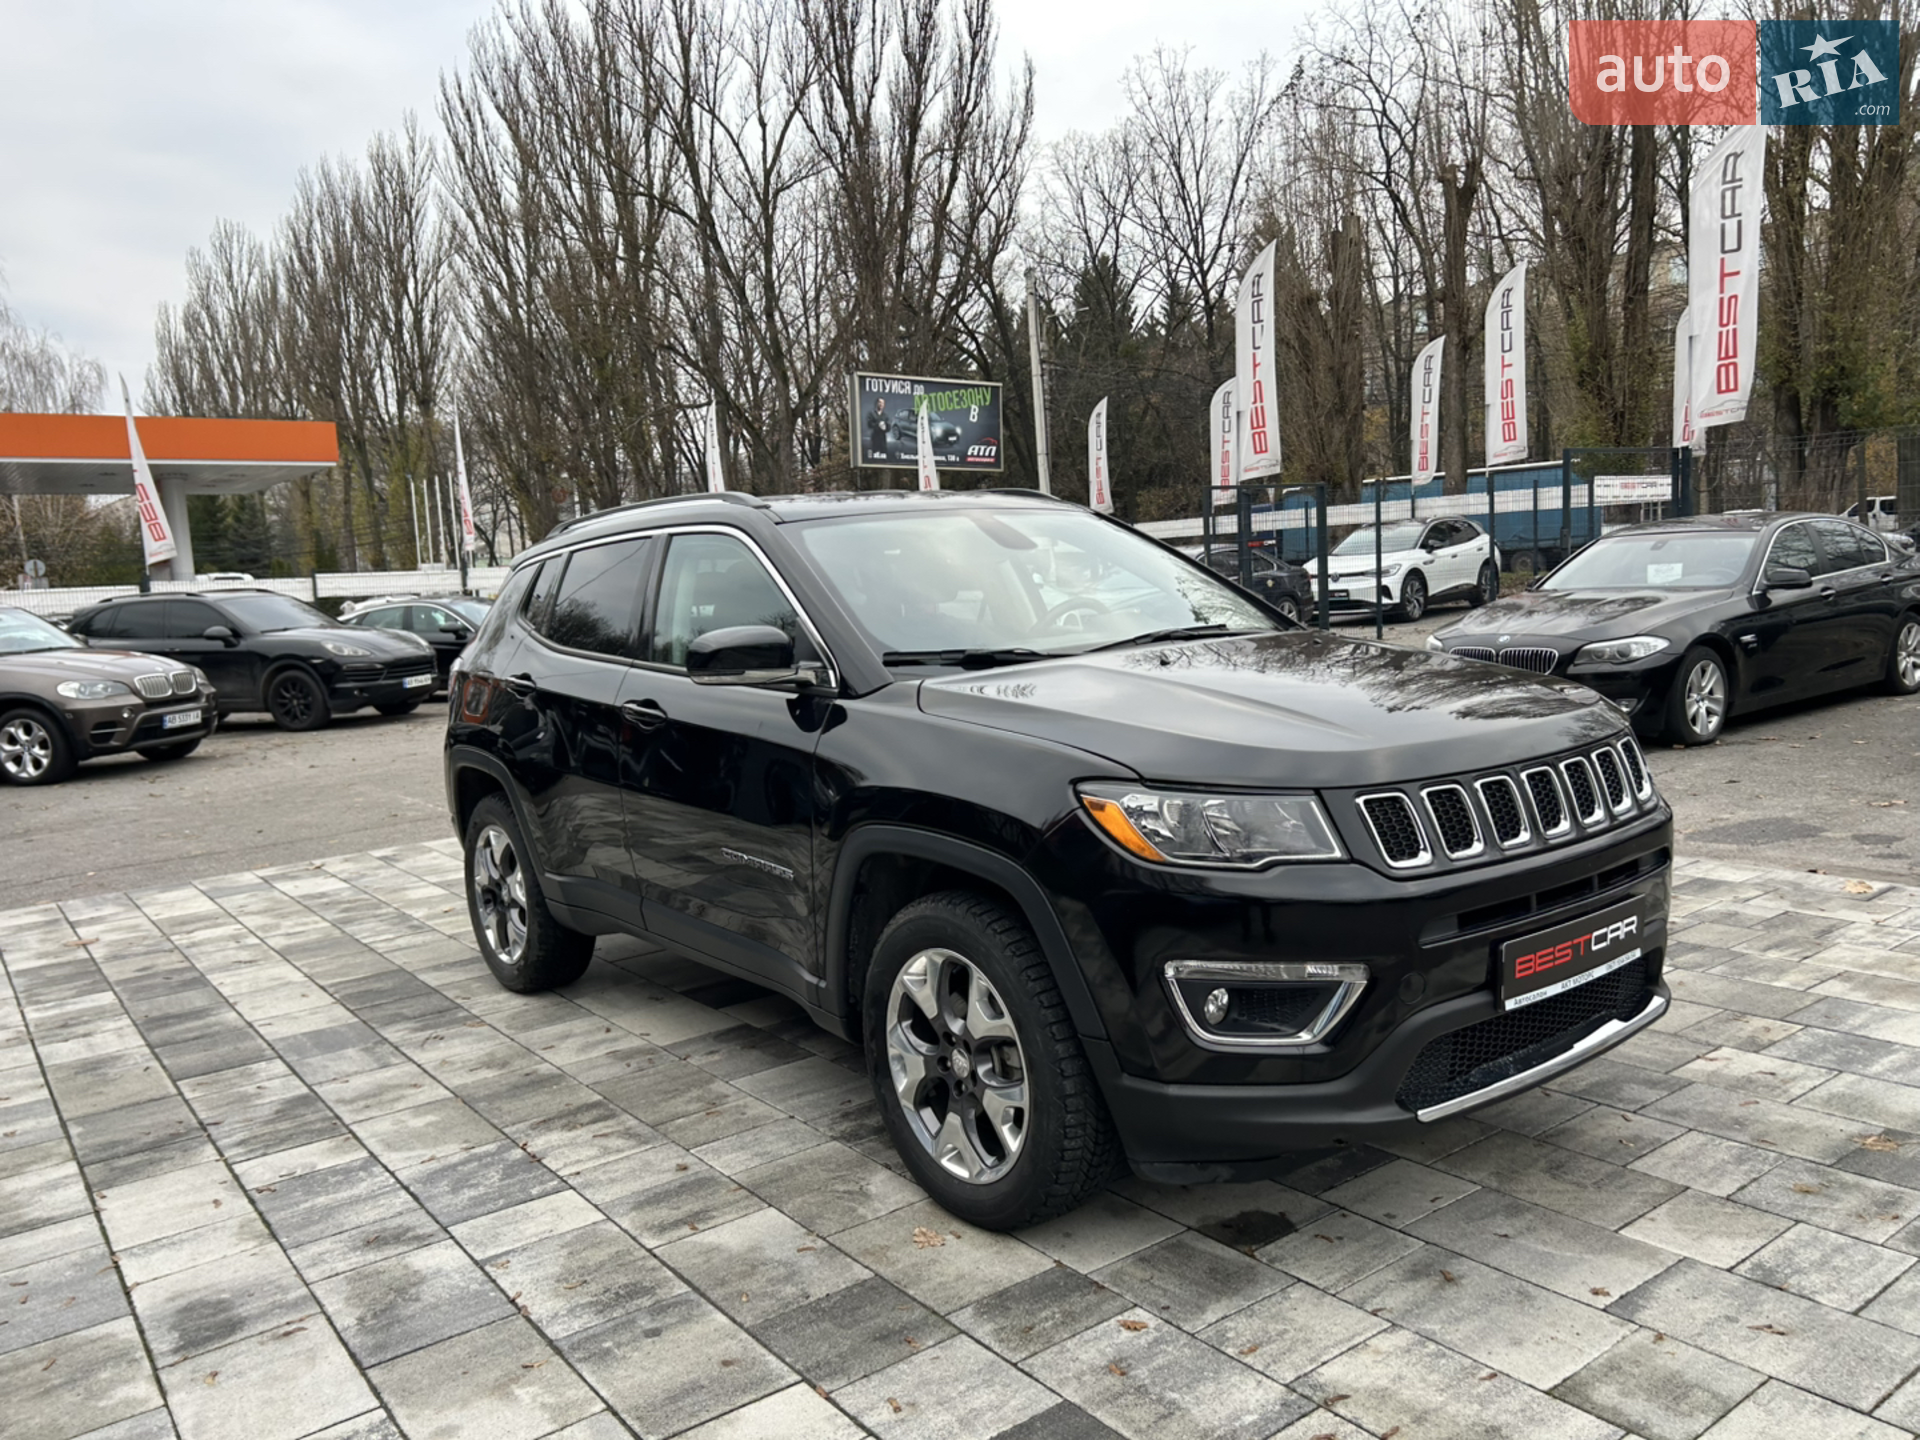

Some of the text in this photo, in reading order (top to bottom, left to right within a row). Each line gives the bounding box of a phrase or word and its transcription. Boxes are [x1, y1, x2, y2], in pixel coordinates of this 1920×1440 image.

[1716, 150, 1744, 395] BESTCAR
[1250, 272, 1269, 455] BESTCAR
[1418, 354, 1434, 471] BESTCAR
[1501, 286, 1518, 443] BESTCAR
[1221, 391, 1232, 492] BESTCAR
[1513, 990, 1548, 1006] Автосалон
[1515, 915, 1638, 979] BESTCAR
